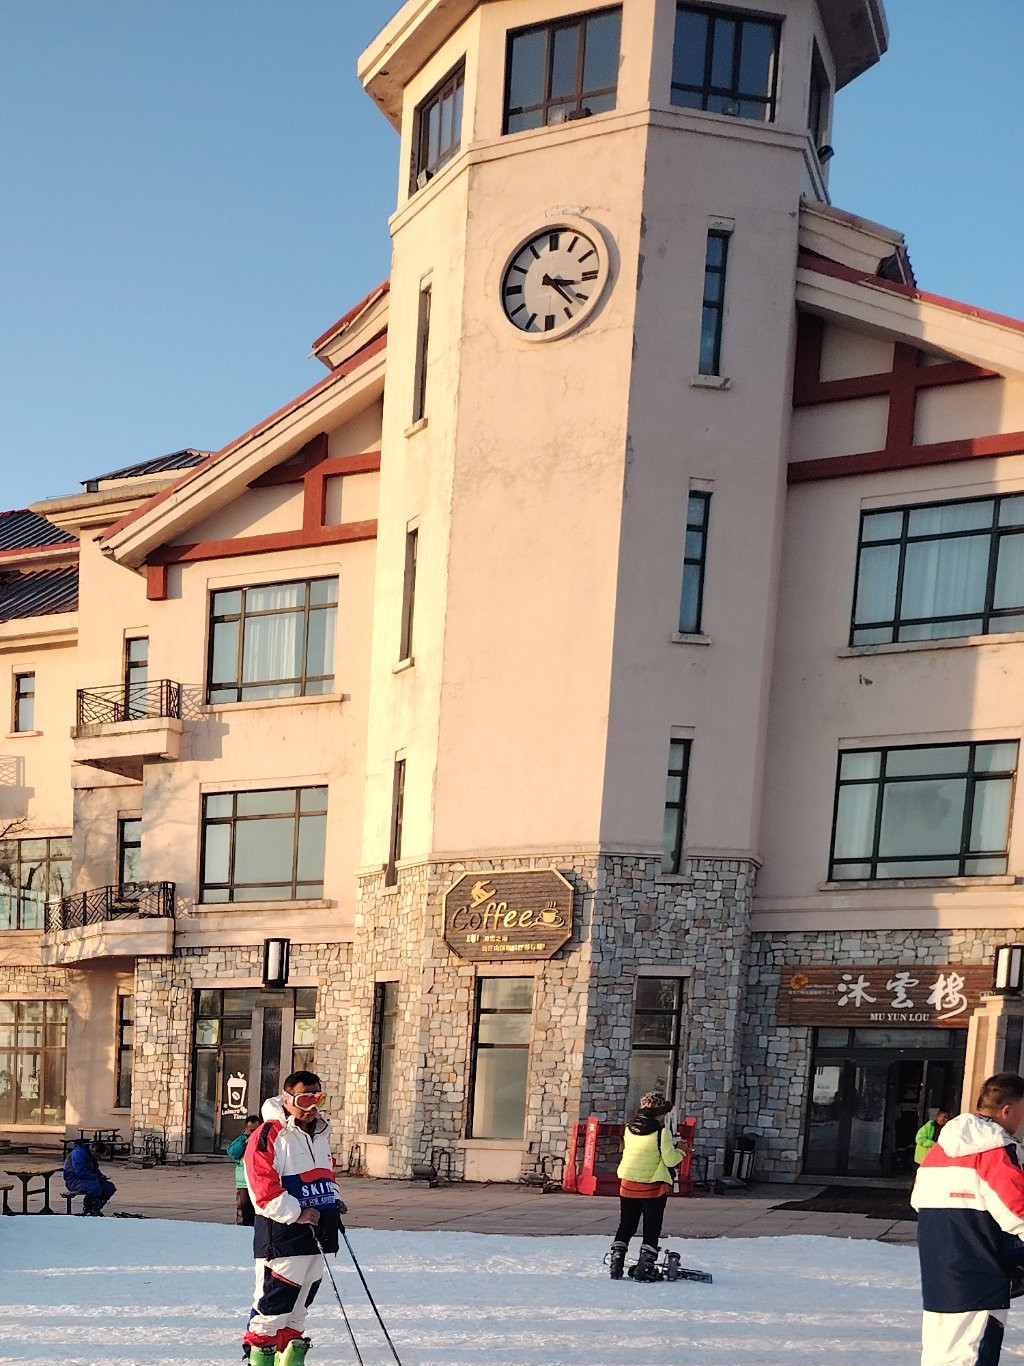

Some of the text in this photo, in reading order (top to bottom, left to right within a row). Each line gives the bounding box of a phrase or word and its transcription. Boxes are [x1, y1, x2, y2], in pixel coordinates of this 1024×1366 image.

[452, 901, 534, 931] Coffee
[869, 1012, 930, 1022] MU YUN LOU
